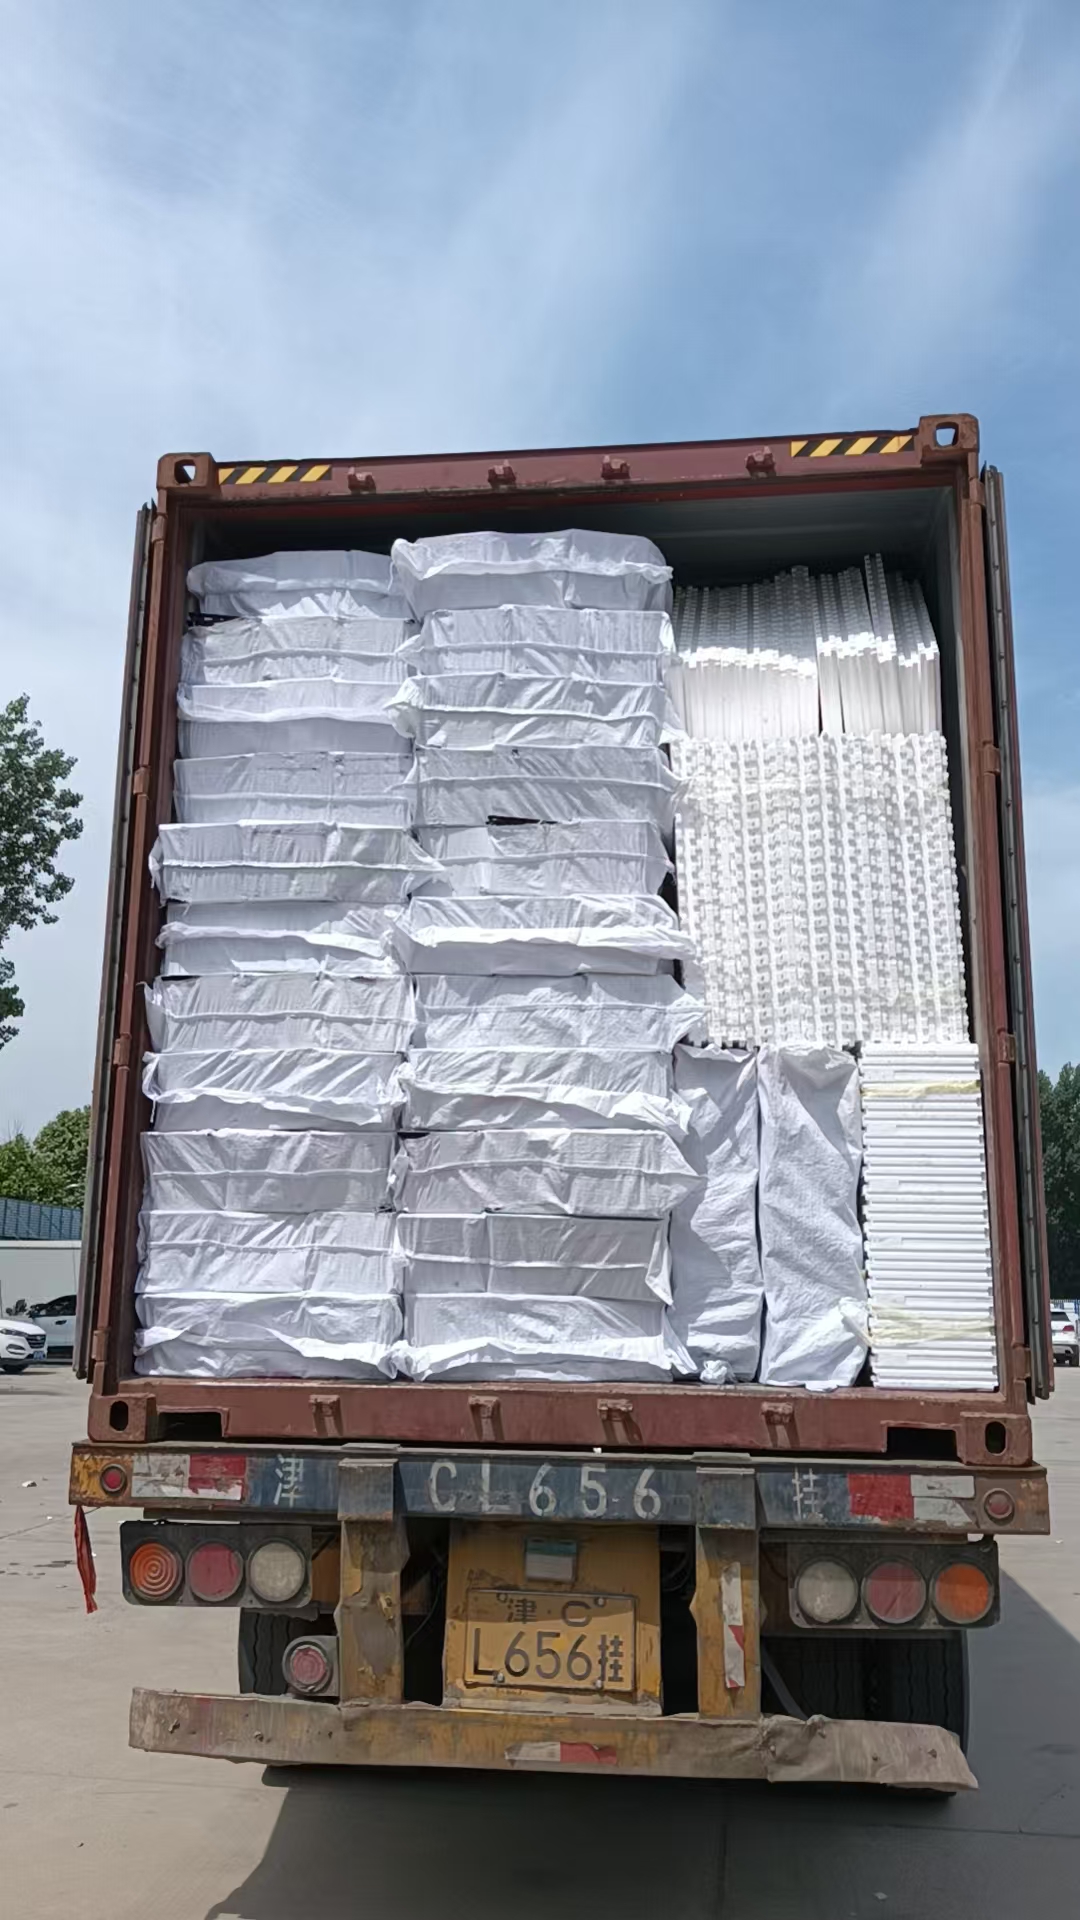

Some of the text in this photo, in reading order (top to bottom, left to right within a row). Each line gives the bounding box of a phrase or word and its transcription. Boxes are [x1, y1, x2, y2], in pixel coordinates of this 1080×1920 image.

[273, 1453, 304, 1508] 津
[429, 1458, 662, 1520] CL656
[473, 1627, 625, 1683] L656挂
